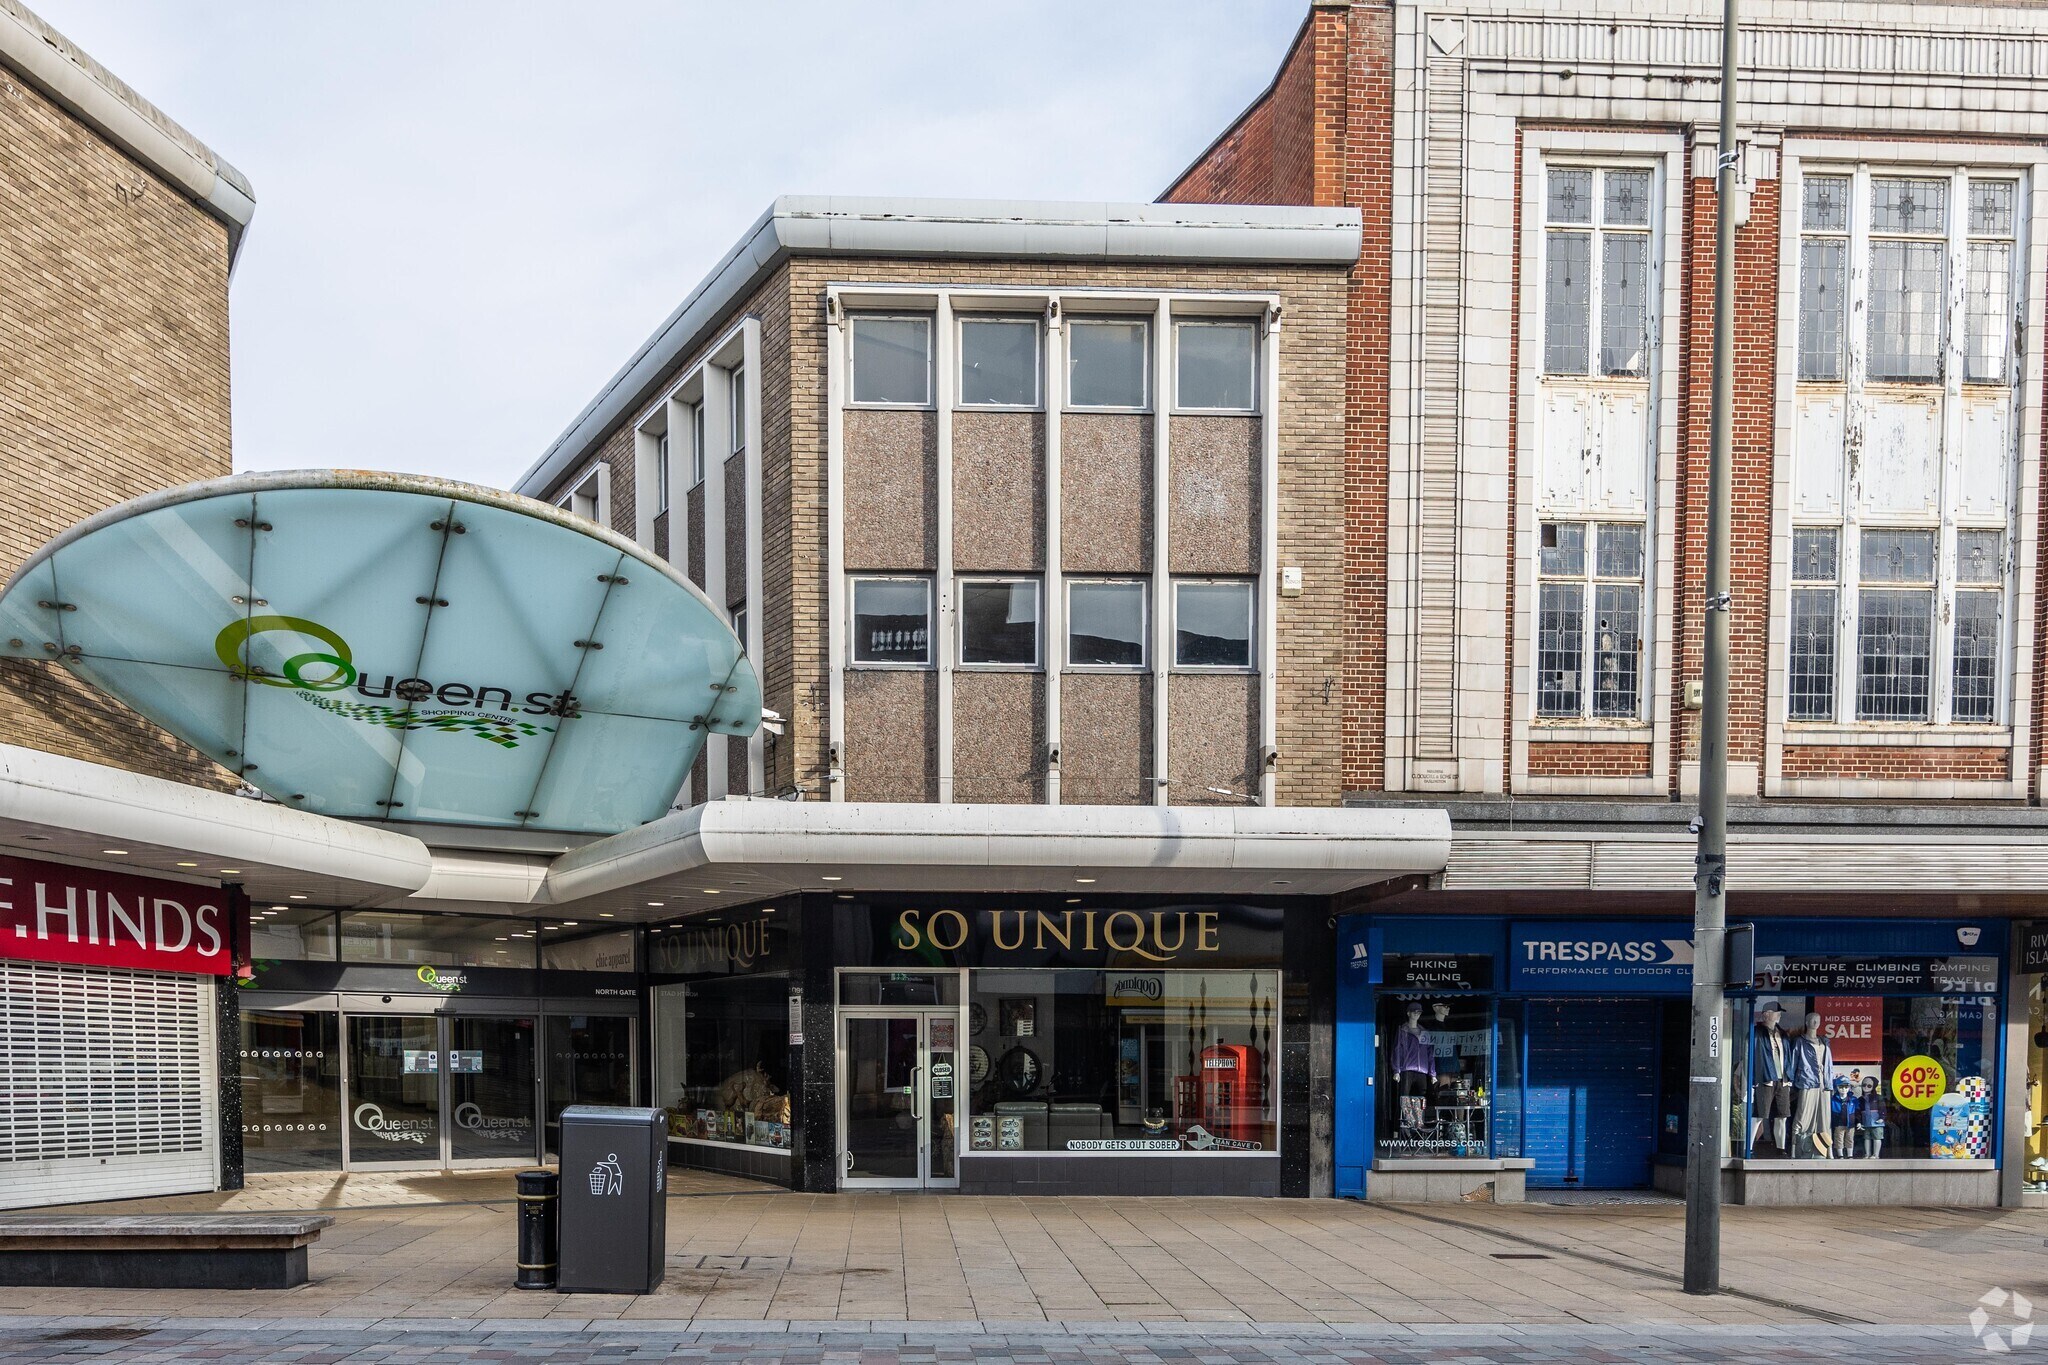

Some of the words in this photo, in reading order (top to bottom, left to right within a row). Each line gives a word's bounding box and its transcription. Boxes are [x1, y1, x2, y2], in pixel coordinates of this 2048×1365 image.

[421, 709, 475, 717] SHOPPING
[477, 711, 518, 725] CENTRE
[898, 909, 970, 952] SO
[988, 909, 1220, 962] UNIQUE
[2030, 933, 2048, 948] RIV
[659, 934, 681, 970] SO
[686, 918, 771, 968] UNIQUE
[1523, 941, 1657, 962] TRESPASS
[595, 952, 608, 968] chic
[608, 947, 631, 969] apparel
[1410, 960, 1458, 969] HIKING
[1764, 963, 1846, 972] ADVENTURE
[1856, 963, 1920, 972] CLIMBING
[1930, 963, 1991, 973] CAMPING
[1522, 967, 1609, 975] PERFORMANCE
[1406, 973, 1461, 982] SAILING
[1771, 975, 1829, 984] CYCLING
[1836, 975, 1922, 984] SNOWSPORT
[1931, 976, 1980, 985] TRAVEL
[595, 988, 618, 996] NORTH
[1825, 1025, 1872, 1039] SALE
[1206, 1058, 1236, 1068] TELEPHONE
[1900, 1066, 1940, 1083] 60%
[1069, 1140, 1103, 1149] NOBODY
[1105, 1140, 1127, 1149] GETS
[1129, 1140, 1147, 1149] OUT
[1149, 1140, 1177, 1149] SOBER
[1215, 1138, 1230, 1146] MAN
[1232, 1140, 1251, 1149] CAVE
[1379, 1137, 1485, 1148] www.trespass.com
